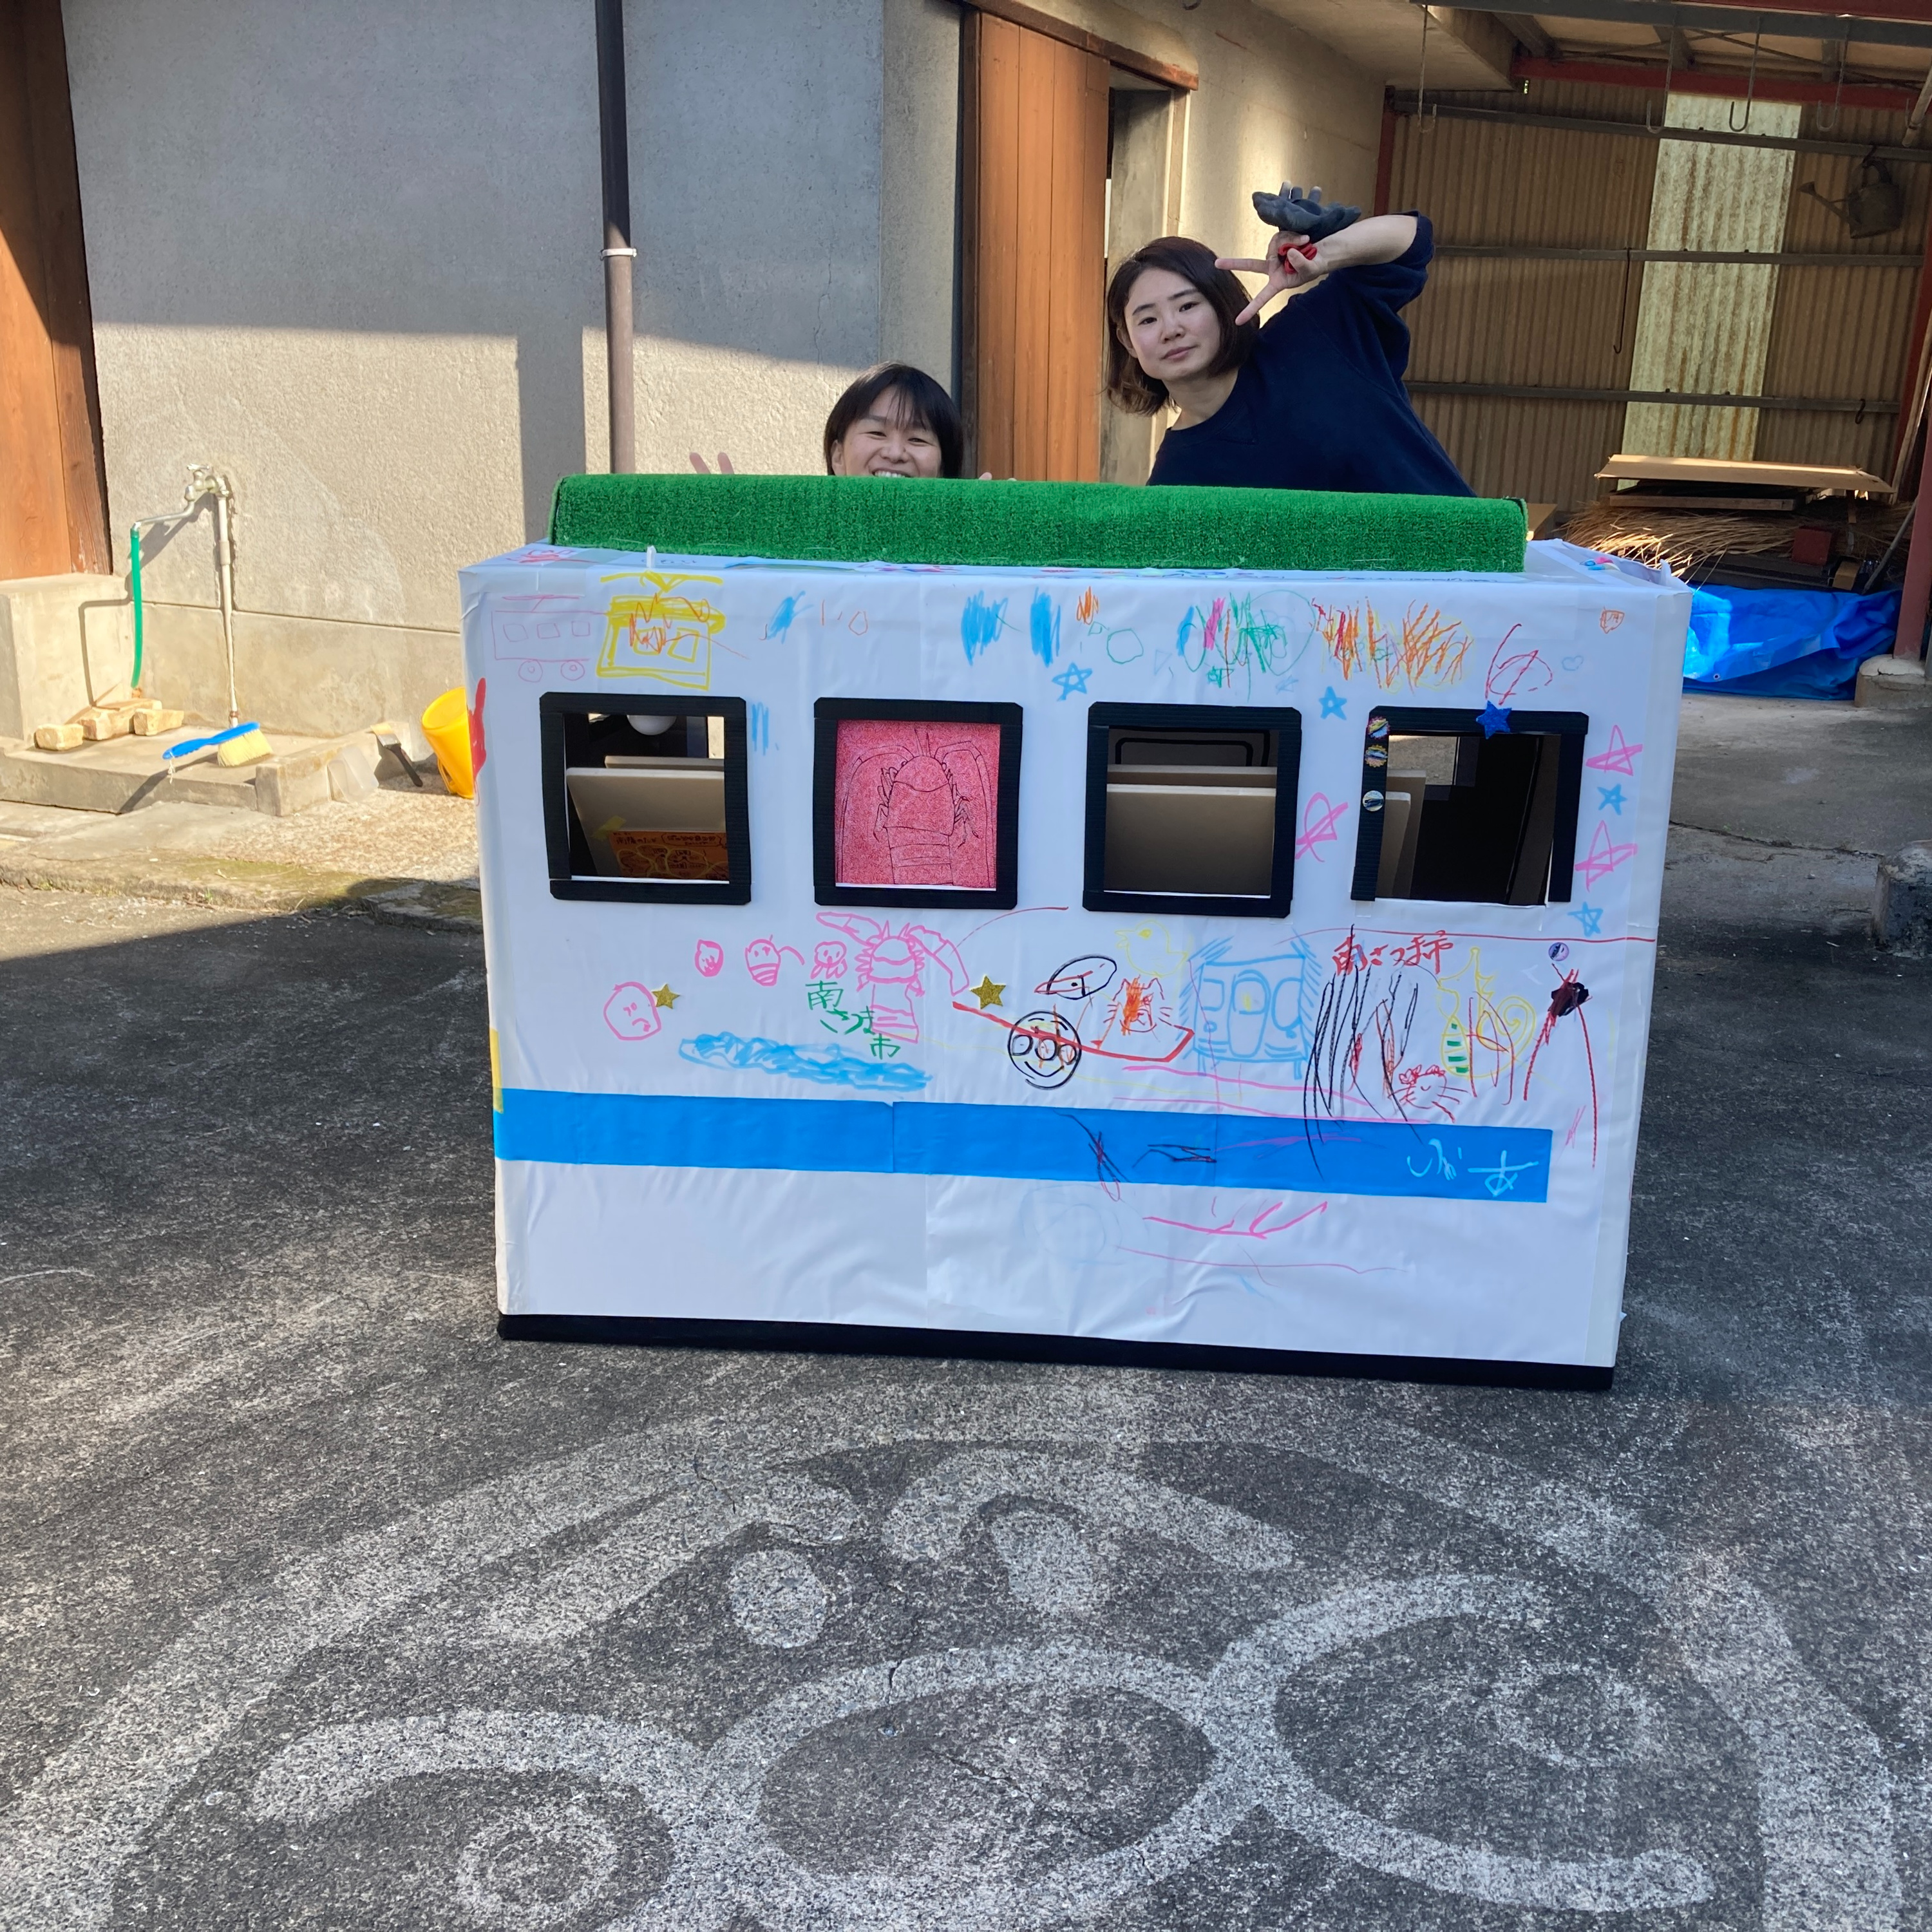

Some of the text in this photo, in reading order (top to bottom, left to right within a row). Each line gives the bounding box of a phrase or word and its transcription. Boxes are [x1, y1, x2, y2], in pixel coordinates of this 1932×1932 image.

[805, 980, 901, 1060] 南さつま市
